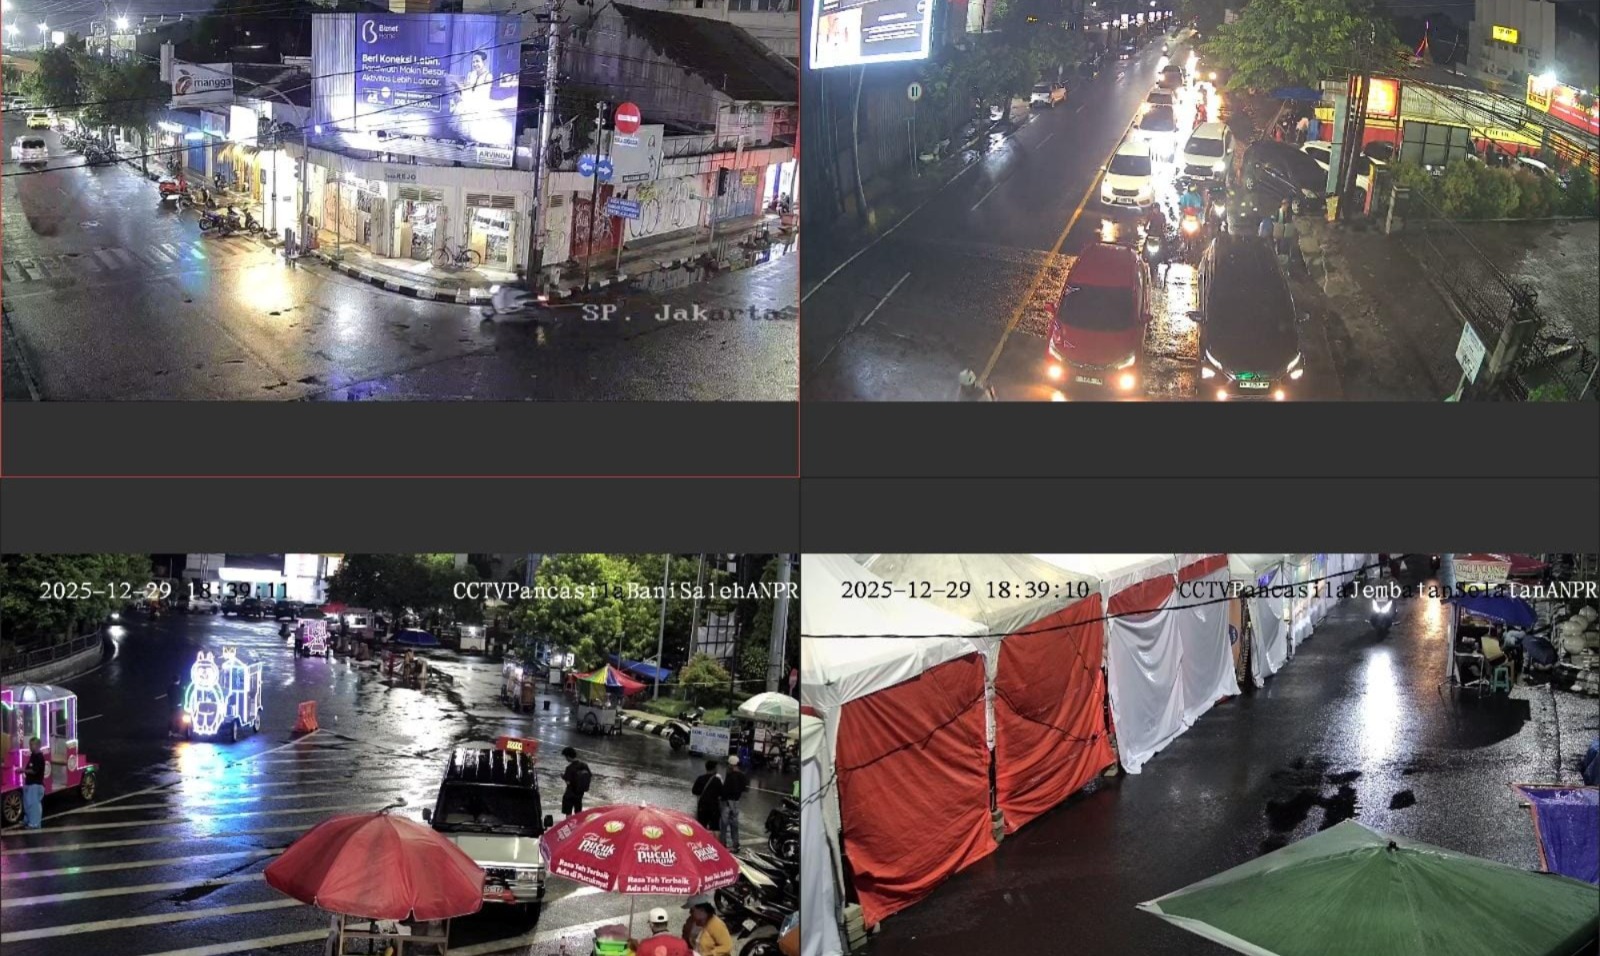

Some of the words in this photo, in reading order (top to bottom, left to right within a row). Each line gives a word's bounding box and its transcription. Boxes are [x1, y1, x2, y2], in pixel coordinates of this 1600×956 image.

[380, 54, 412, 64] Koneksi
[193, 78, 231, 89] mangga
[637, 848, 677, 863] pucuk
[661, 876, 689, 885] Terbaik
[626, 884, 641, 892] Ada
